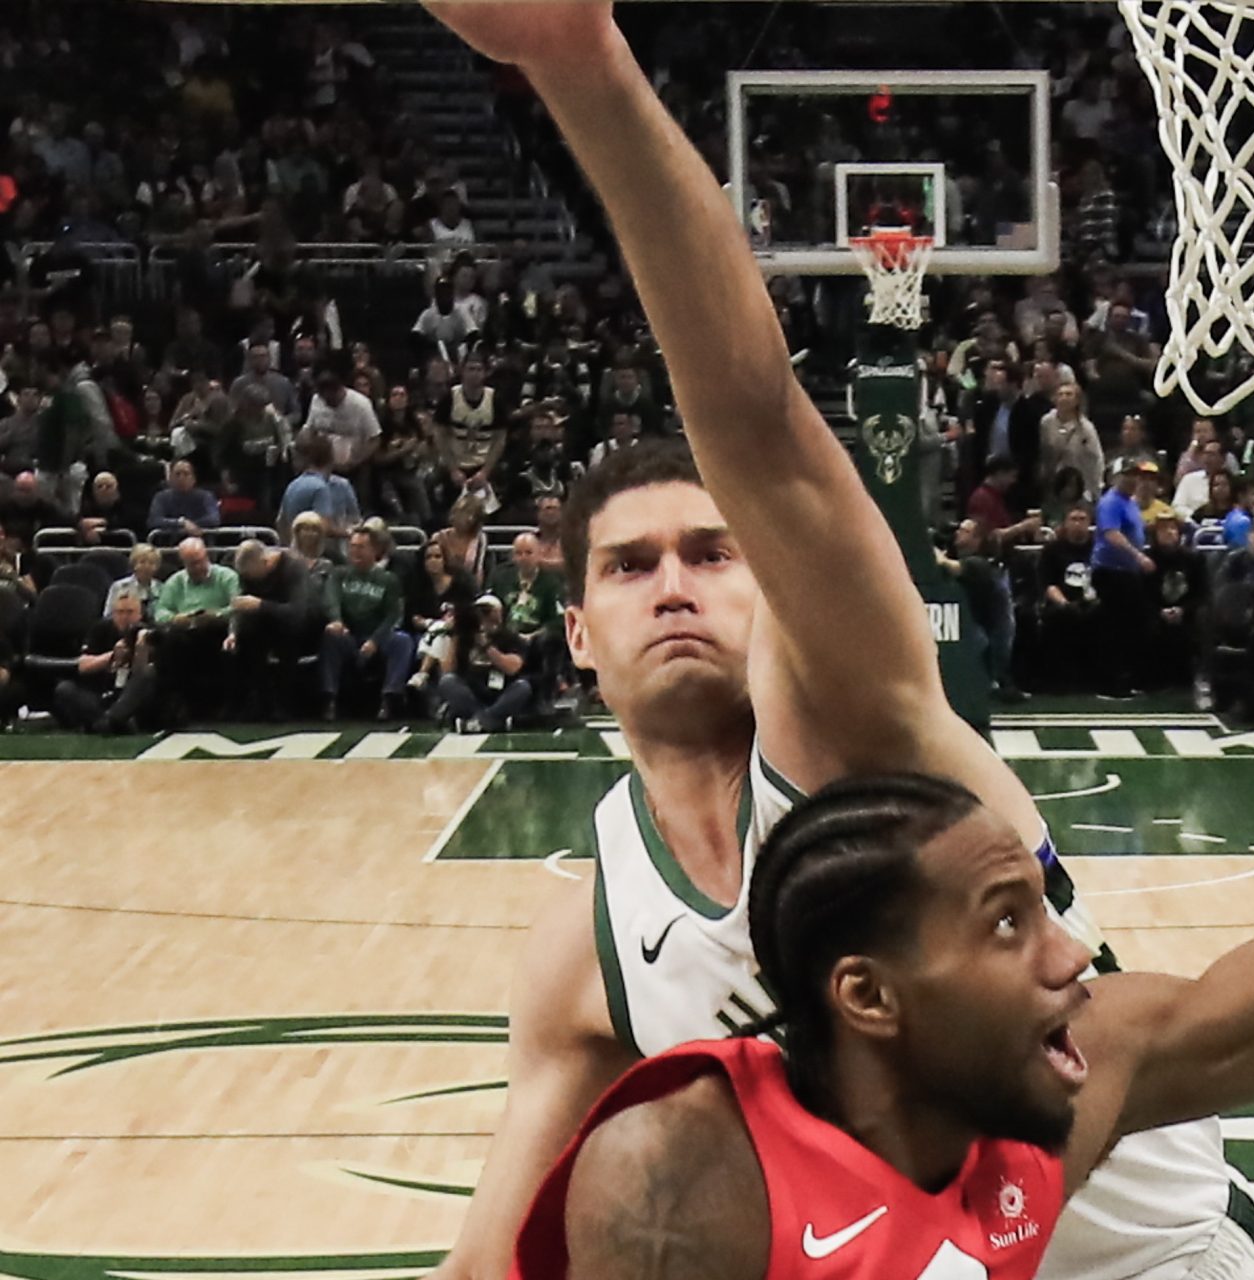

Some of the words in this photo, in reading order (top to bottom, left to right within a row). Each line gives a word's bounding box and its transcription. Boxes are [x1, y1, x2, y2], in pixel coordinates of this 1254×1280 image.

[923, 602, 960, 641] RN
[989, 1231, 1018, 1251] Sun
[1017, 1221, 1040, 1241] Life
